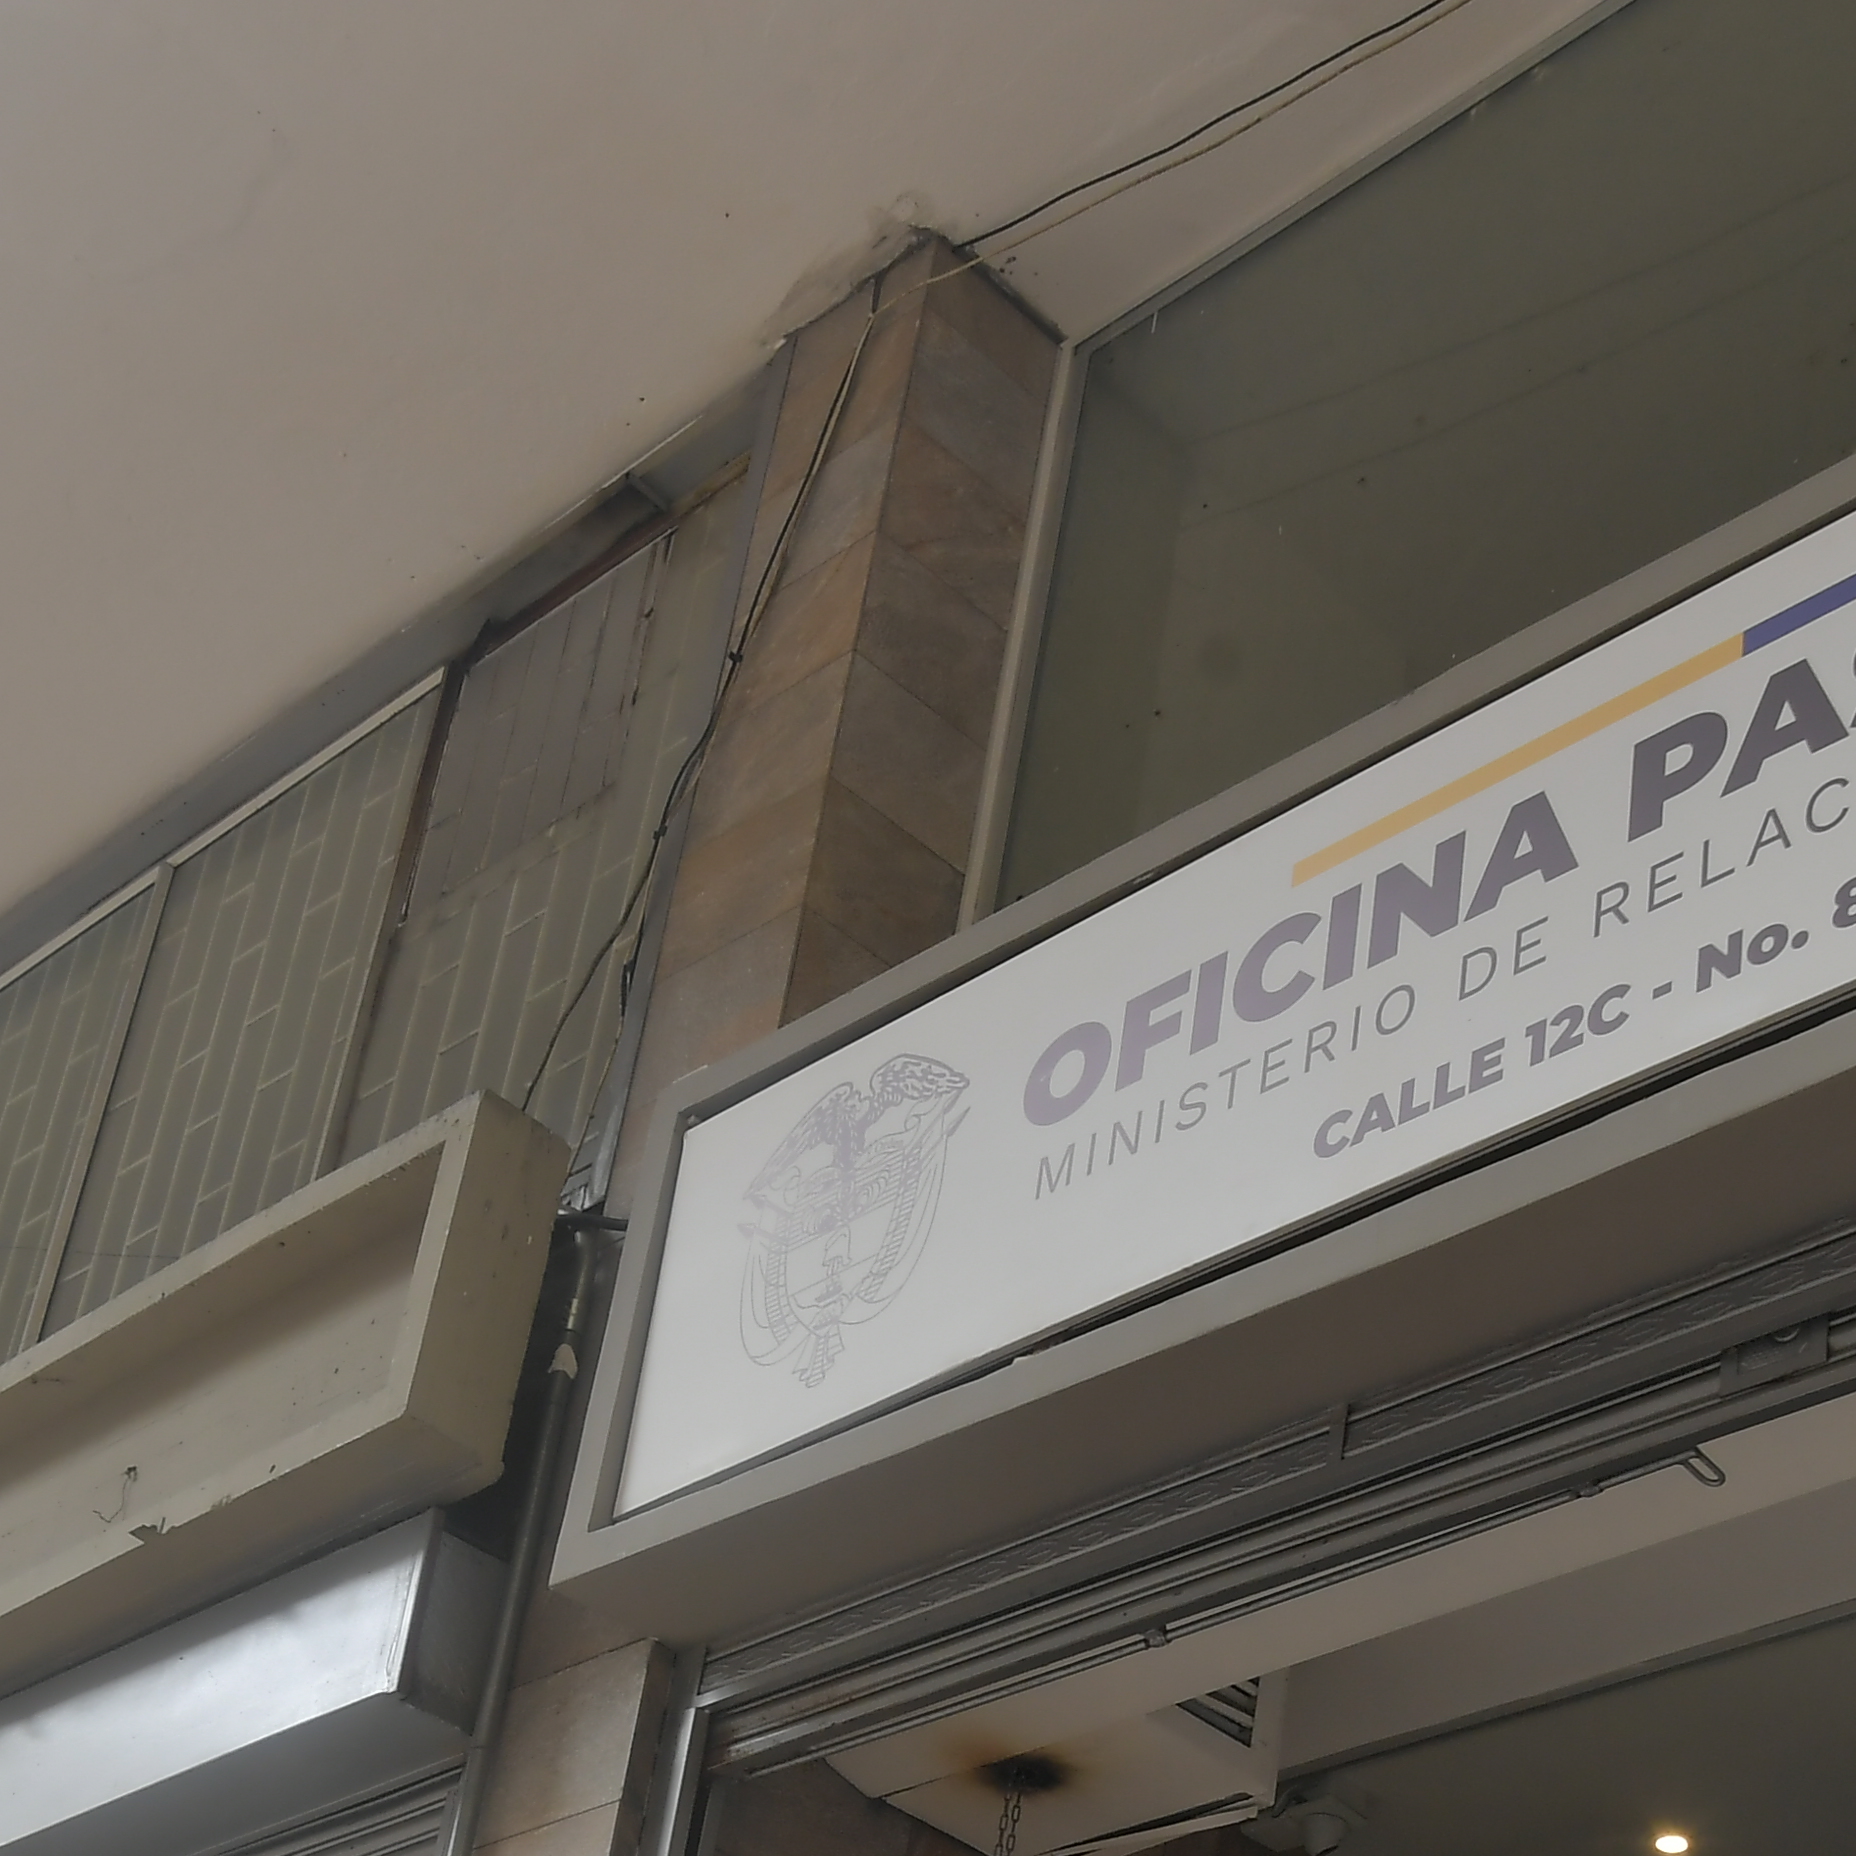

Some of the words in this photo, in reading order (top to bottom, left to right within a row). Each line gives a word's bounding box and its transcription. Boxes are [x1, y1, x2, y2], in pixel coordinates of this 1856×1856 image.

[1023, 790, 1579, 1127] OFICINA
[1035, 984, 1416, 1200] MINISTERIO
[1458, 916, 1549, 1001] DE
[1313, 1037, 1507, 1159] CALLE
[1524, 983, 1632, 1068] 12C
[1695, 919, 1811, 993] No.
